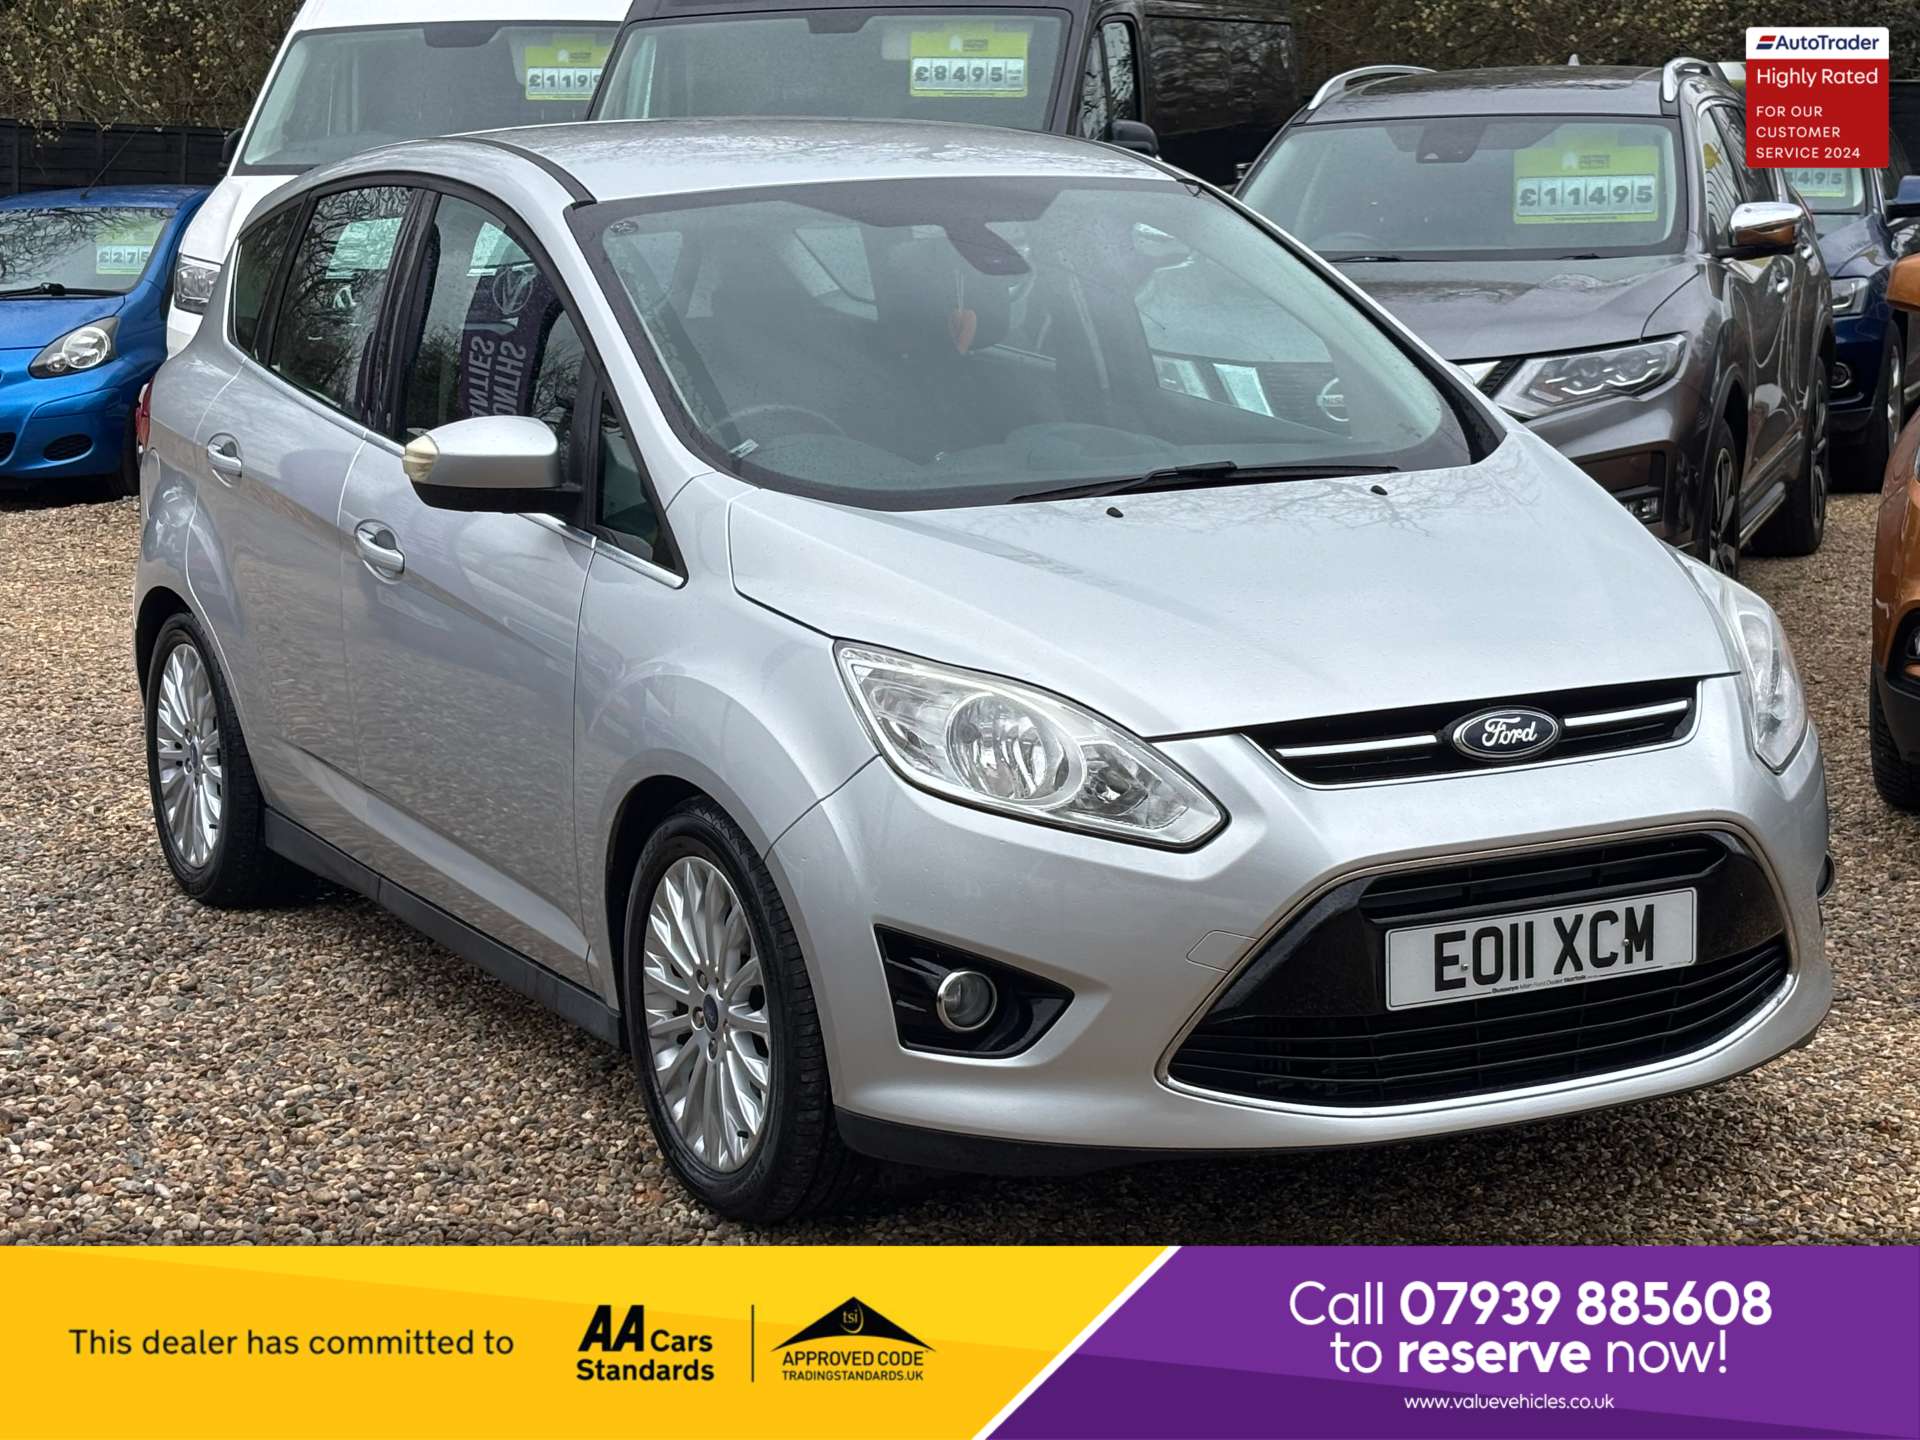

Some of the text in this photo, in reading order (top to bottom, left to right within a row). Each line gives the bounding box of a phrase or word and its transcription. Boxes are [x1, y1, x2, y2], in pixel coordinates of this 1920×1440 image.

[914, 65, 1003, 81] £8495
[1519, 185, 1654, 207] £11495
[1481, 716, 1539, 747] Ford
[1433, 903, 1656, 993] EO11 XCM
